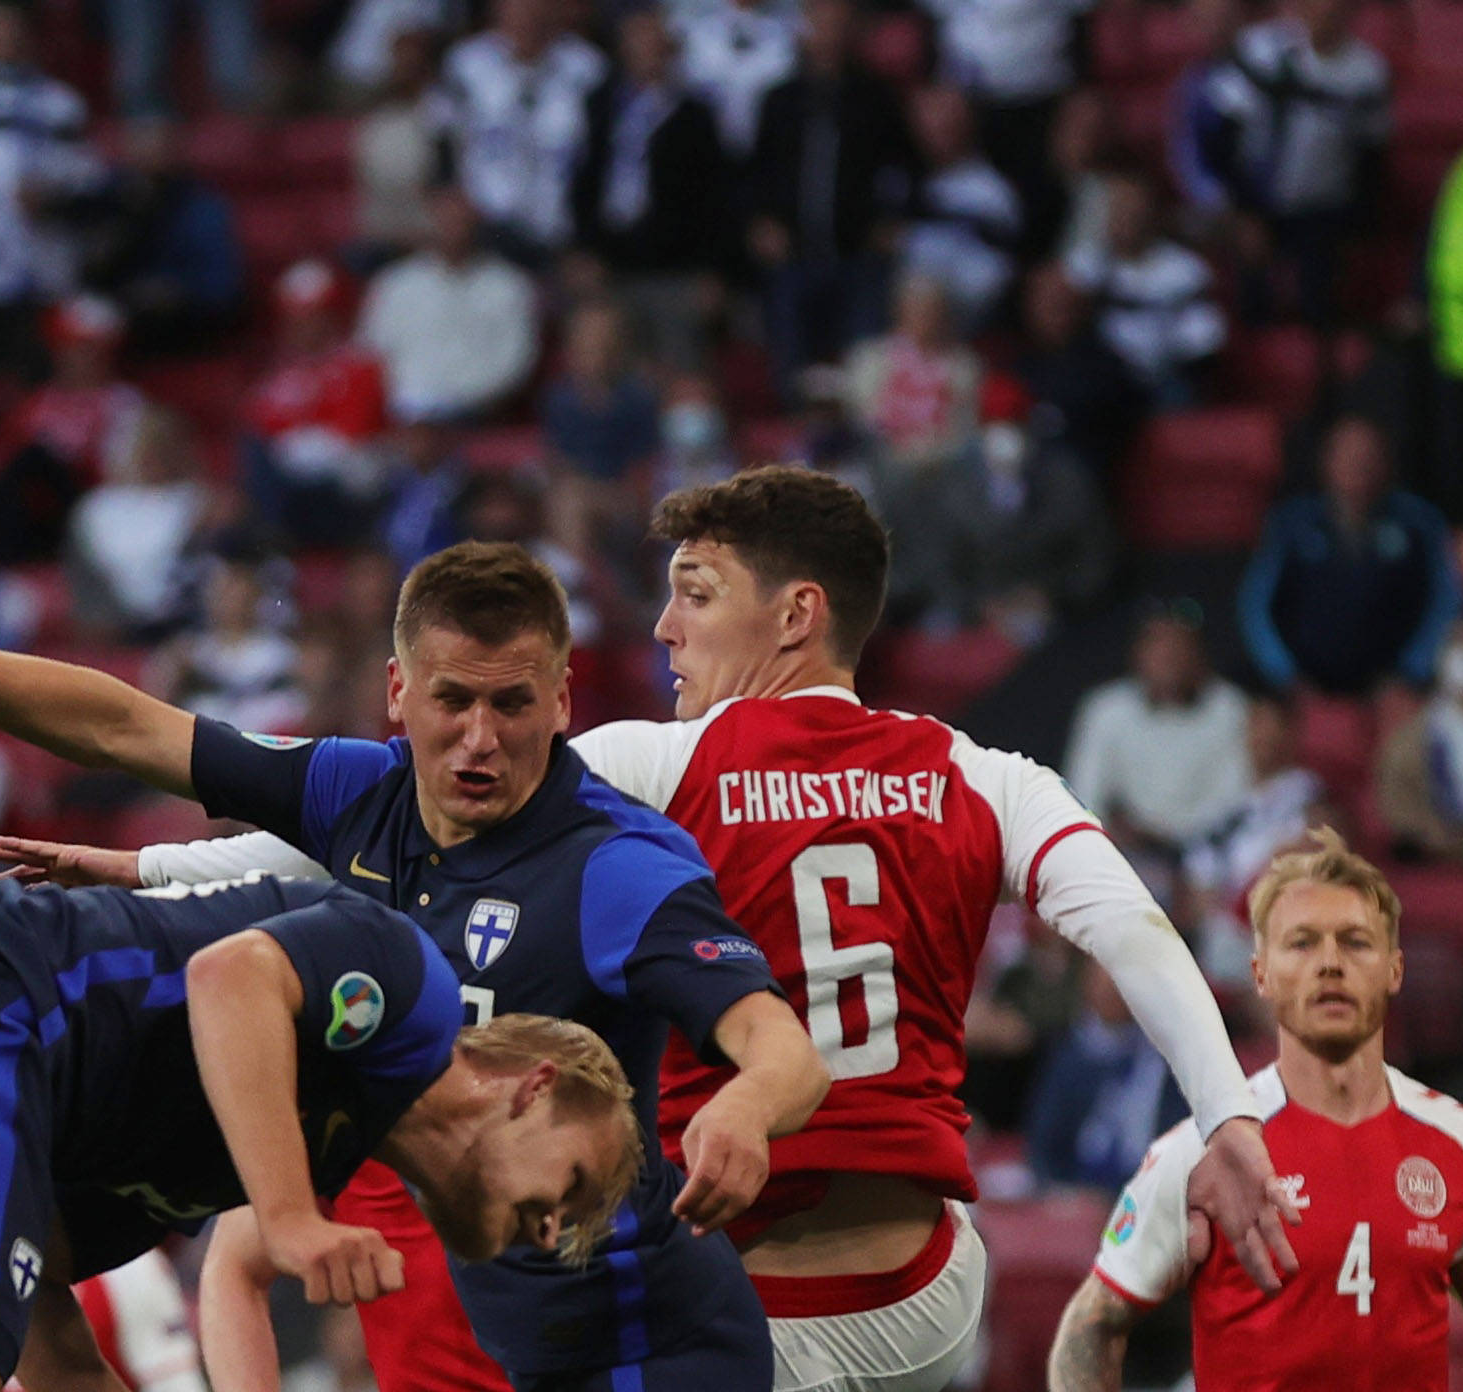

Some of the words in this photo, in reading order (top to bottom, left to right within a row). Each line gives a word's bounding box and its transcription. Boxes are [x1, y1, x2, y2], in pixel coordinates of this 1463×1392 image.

[718, 768, 947, 825] CHRISTENSEN
[790, 843, 900, 1081] 6
[1337, 1221, 1375, 1316] 4
